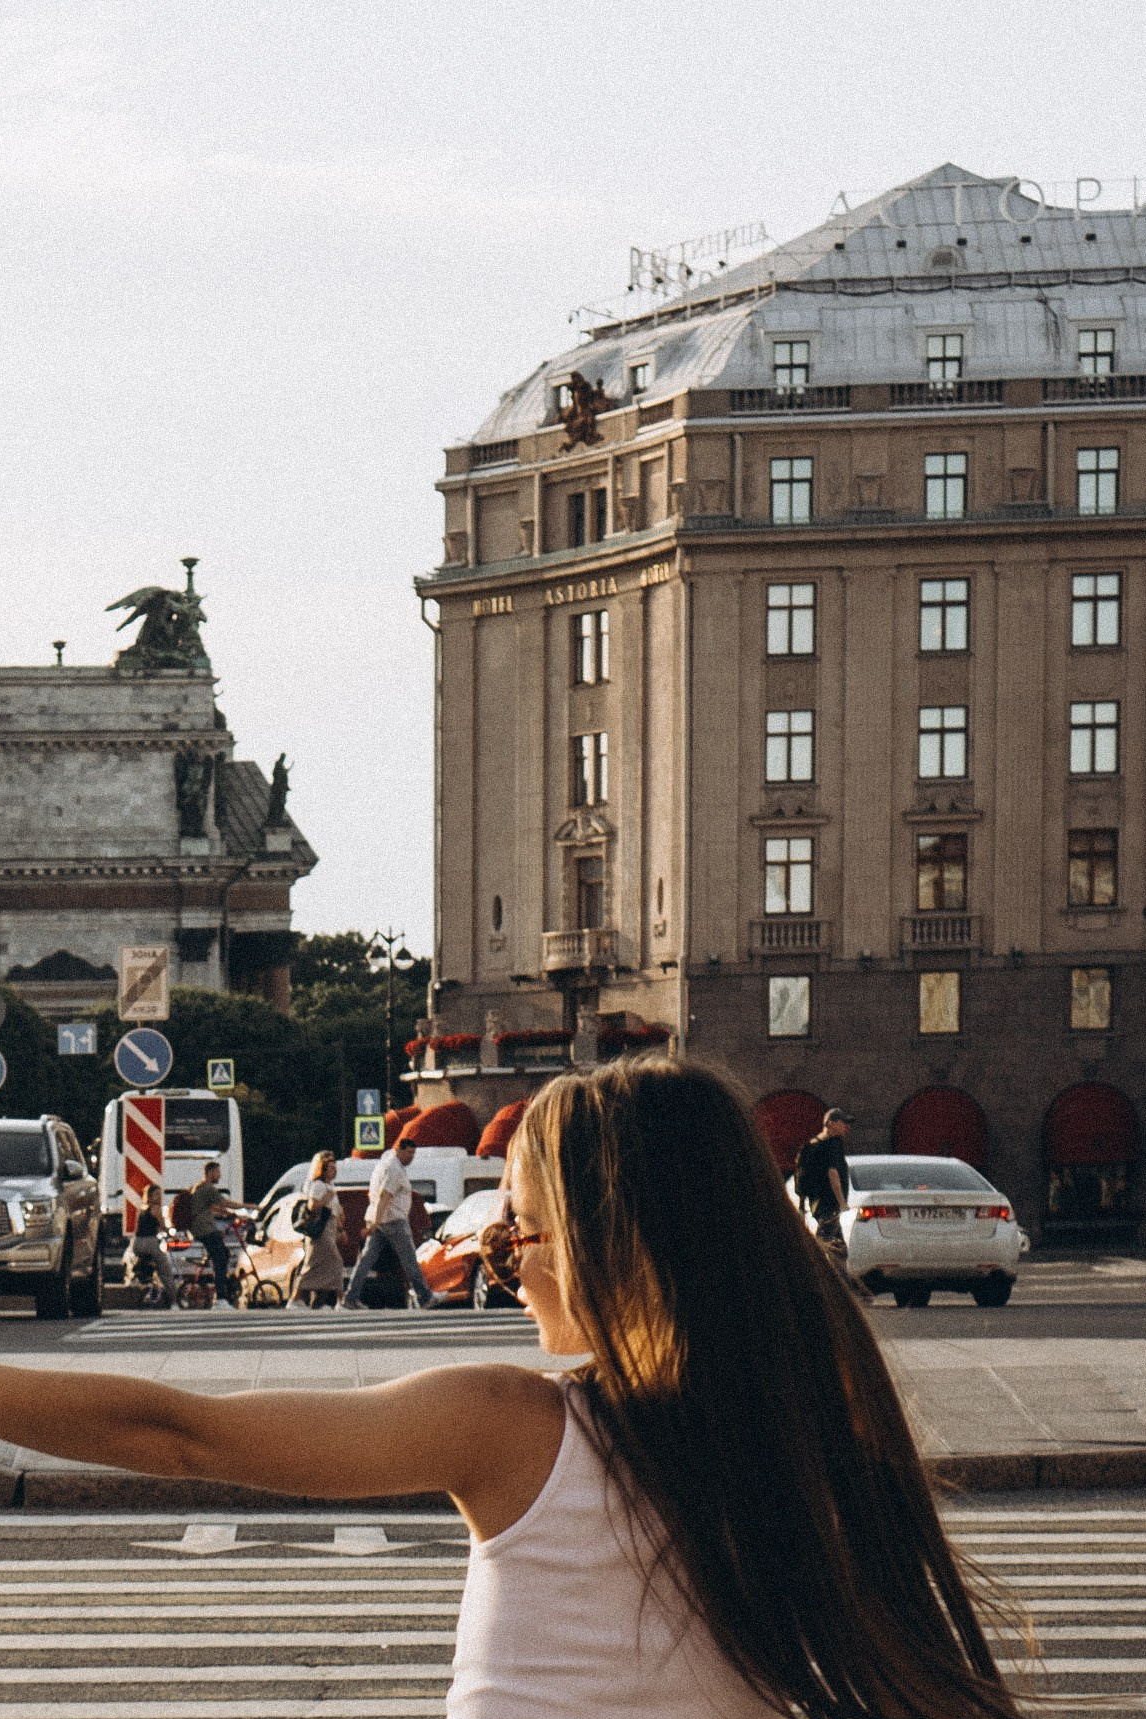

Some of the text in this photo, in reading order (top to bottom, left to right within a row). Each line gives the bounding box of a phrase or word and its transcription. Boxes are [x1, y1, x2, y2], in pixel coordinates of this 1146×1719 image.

[828, 176, 1146, 228] АСТОР
[472, 562, 670, 616] HOTEL ASTORIA HOTEL
